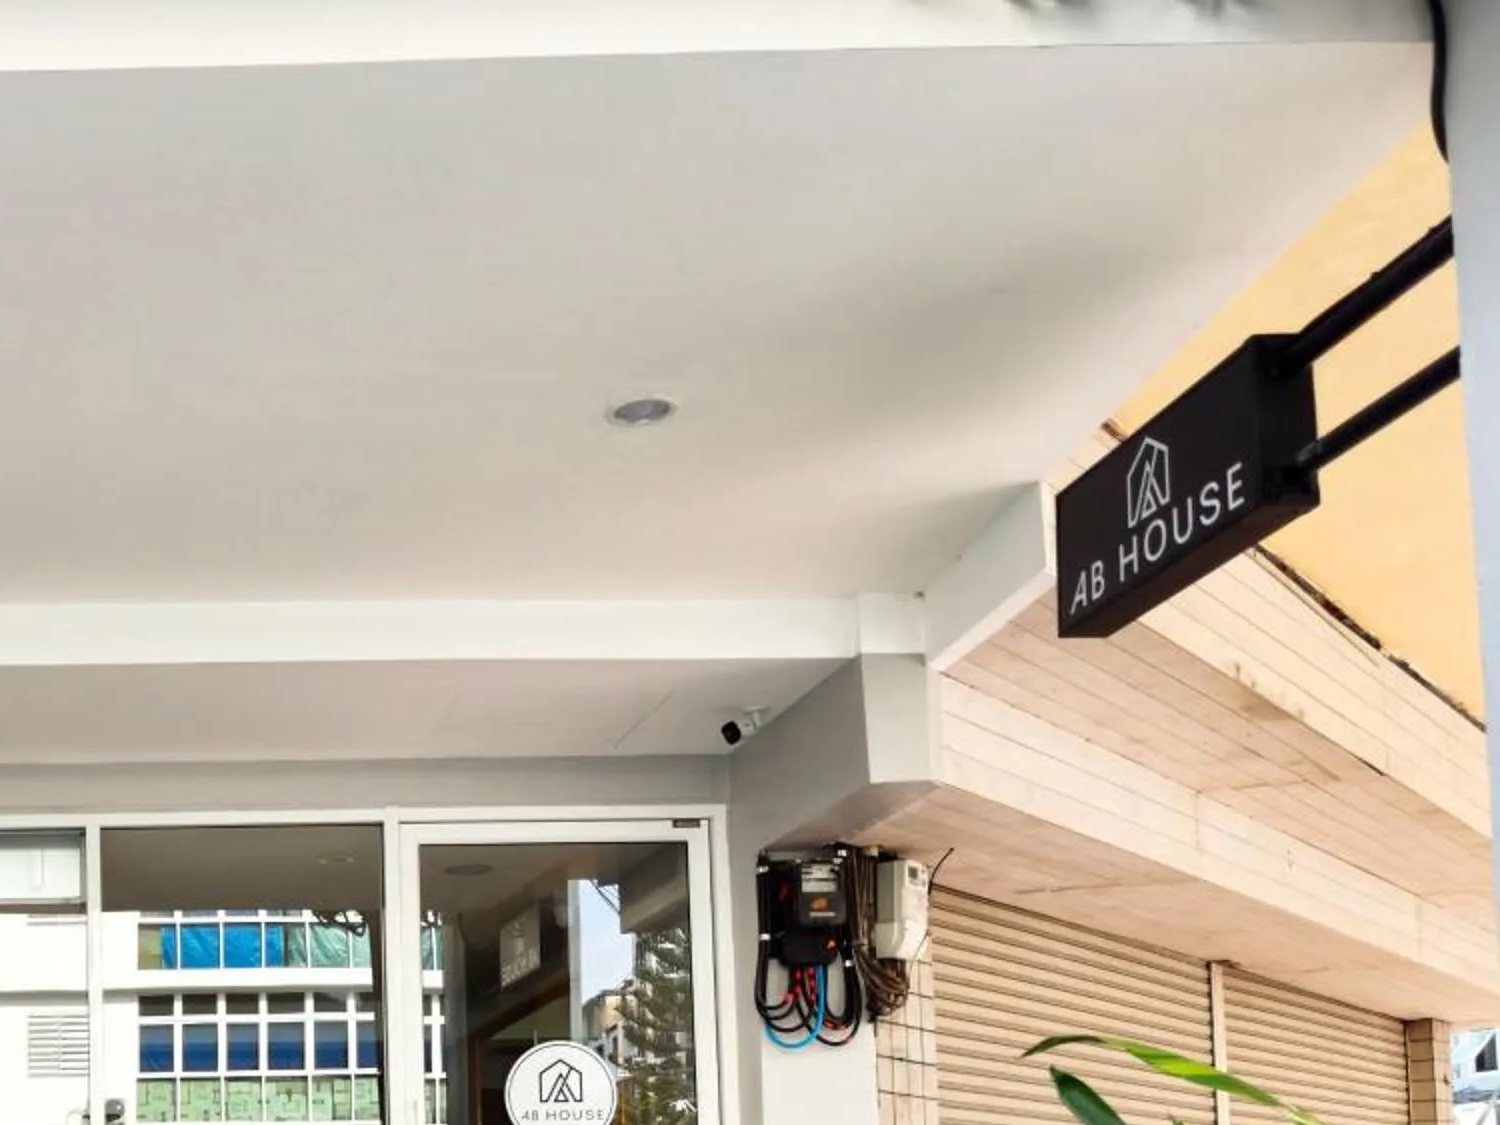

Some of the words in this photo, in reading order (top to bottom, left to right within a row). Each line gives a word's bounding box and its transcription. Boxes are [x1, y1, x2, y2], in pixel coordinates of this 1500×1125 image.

[1070, 559, 1106, 616] AB
[1118, 461, 1246, 583] HOUSE
[545, 1109, 605, 1121] HOUSE
